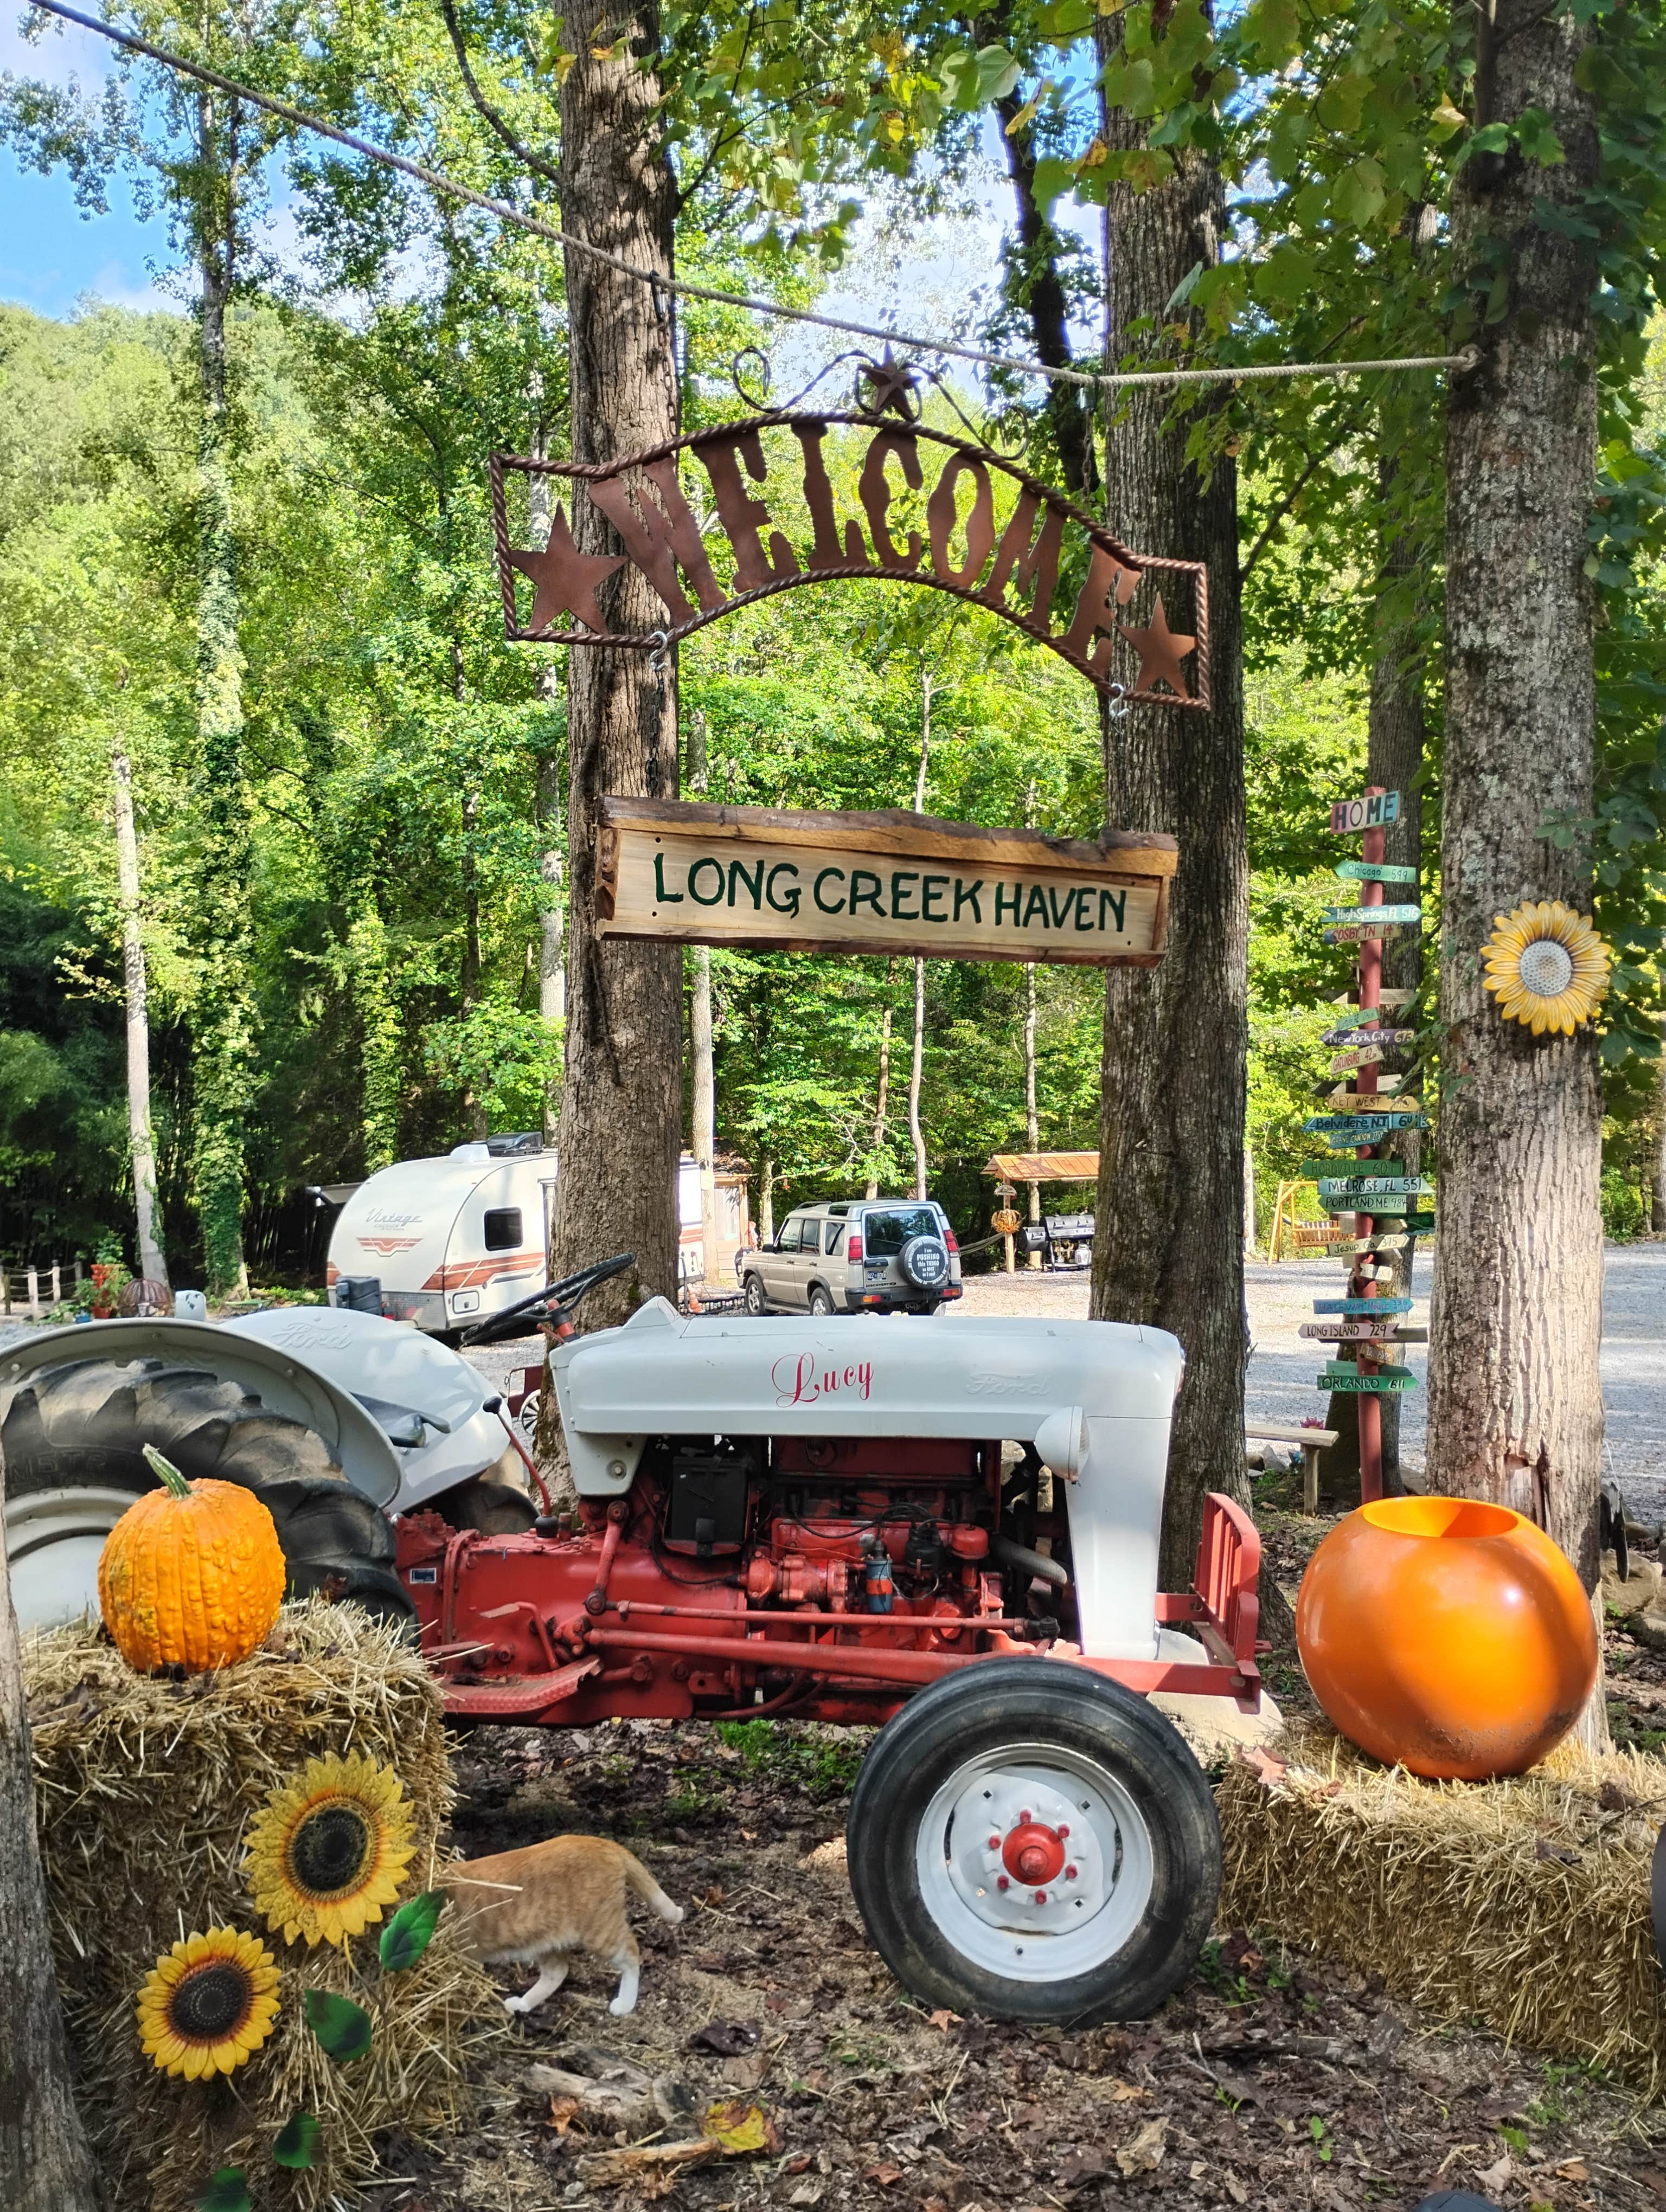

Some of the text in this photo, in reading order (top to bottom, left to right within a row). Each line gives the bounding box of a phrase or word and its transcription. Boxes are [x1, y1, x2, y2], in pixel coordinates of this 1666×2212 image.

[588, 421, 1141, 680] WELCOME
[1334, 793, 1396, 829] HOME
[1347, 864, 1408, 881] Chicago 599
[654, 852, 1127, 933] LONG CREEK HAVEN
[1337, 908, 1355, 921] High
[1388, 908, 1398, 919] FL
[1363, 925, 1376, 937] TN
[1383, 924, 1393, 935] 14
[1330, 1034, 1351, 1044] New
[1351, 1032, 1371, 1043] York
[1372, 1031, 1391, 1044] City
[1364, 1047, 1373, 1062] 42
[1332, 1095, 1349, 1107] KEY
[1356, 1096, 1381, 1107] WEST
[1371, 1116, 1388, 1128] NJ
[1350, 1131, 1371, 1144] CANYON
[1312, 1162, 1364, 1175] HOBOVILLE
[1373, 1162, 1388, 1175] 60
[1329, 1178, 1422, 1193] MELROSE, FL 551
[1376, 1196, 1388, 1208] ME
[1392, 1198, 1407, 1208] 984
[366, 1207, 423, 1227] Vintage
[1383, 1237, 1398, 1247] 375
[271, 1320, 355, 1350] Ford
[1307, 1324, 1387, 1337] LONG ISLAND 729
[771, 1352, 874, 1409] Lucy
[965, 1369, 1052, 1397] Ford
[1322, 1377, 1405, 1390] ORLANDO 611
